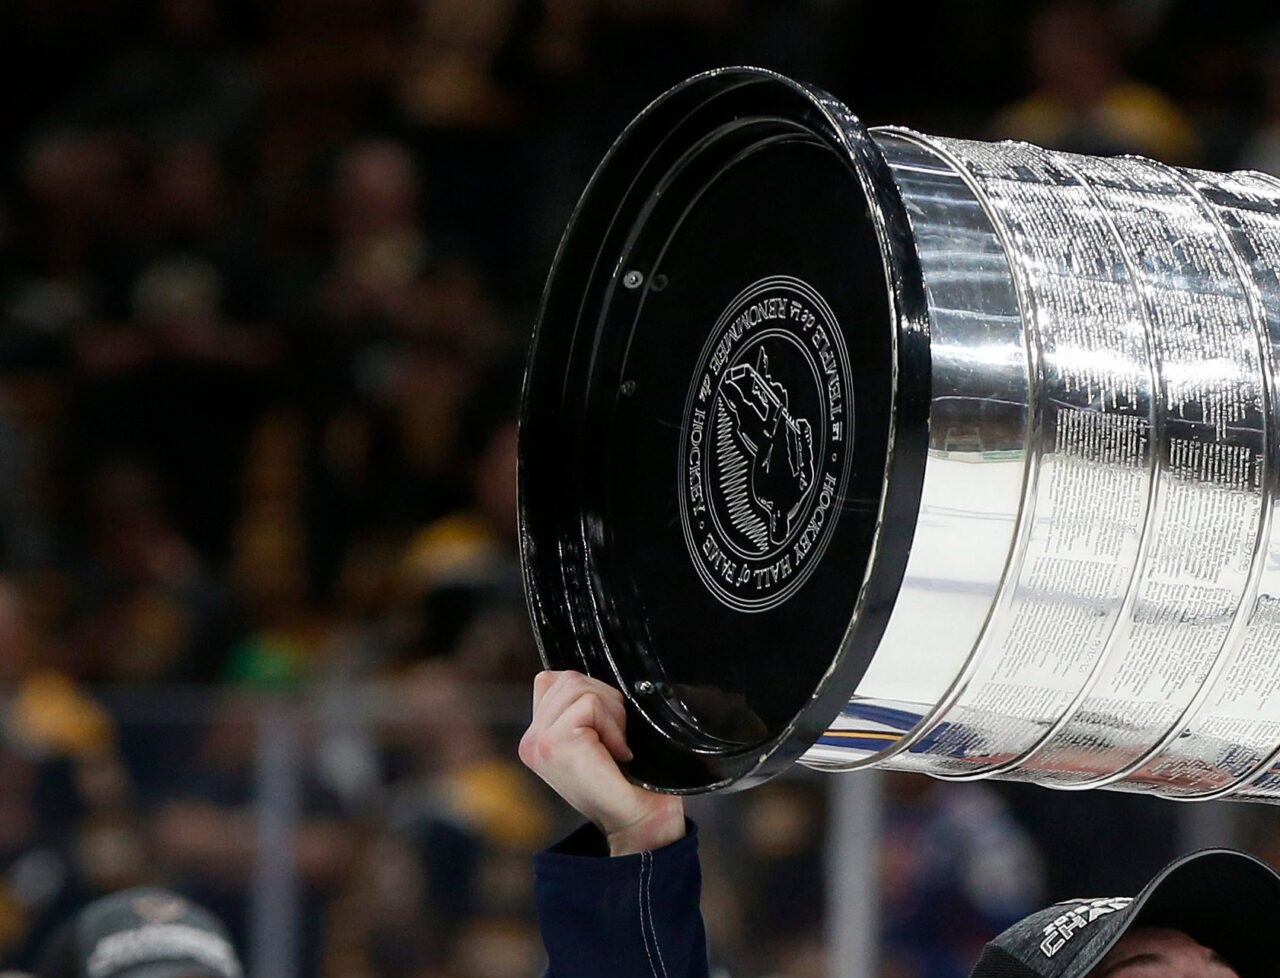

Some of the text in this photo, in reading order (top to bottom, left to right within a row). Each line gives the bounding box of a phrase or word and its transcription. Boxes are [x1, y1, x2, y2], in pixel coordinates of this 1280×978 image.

[813, 323, 842, 421] TEMPLE
[687, 406, 705, 518] HOCKEY
[702, 471, 837, 589] HOCKEY HALL of FAME
